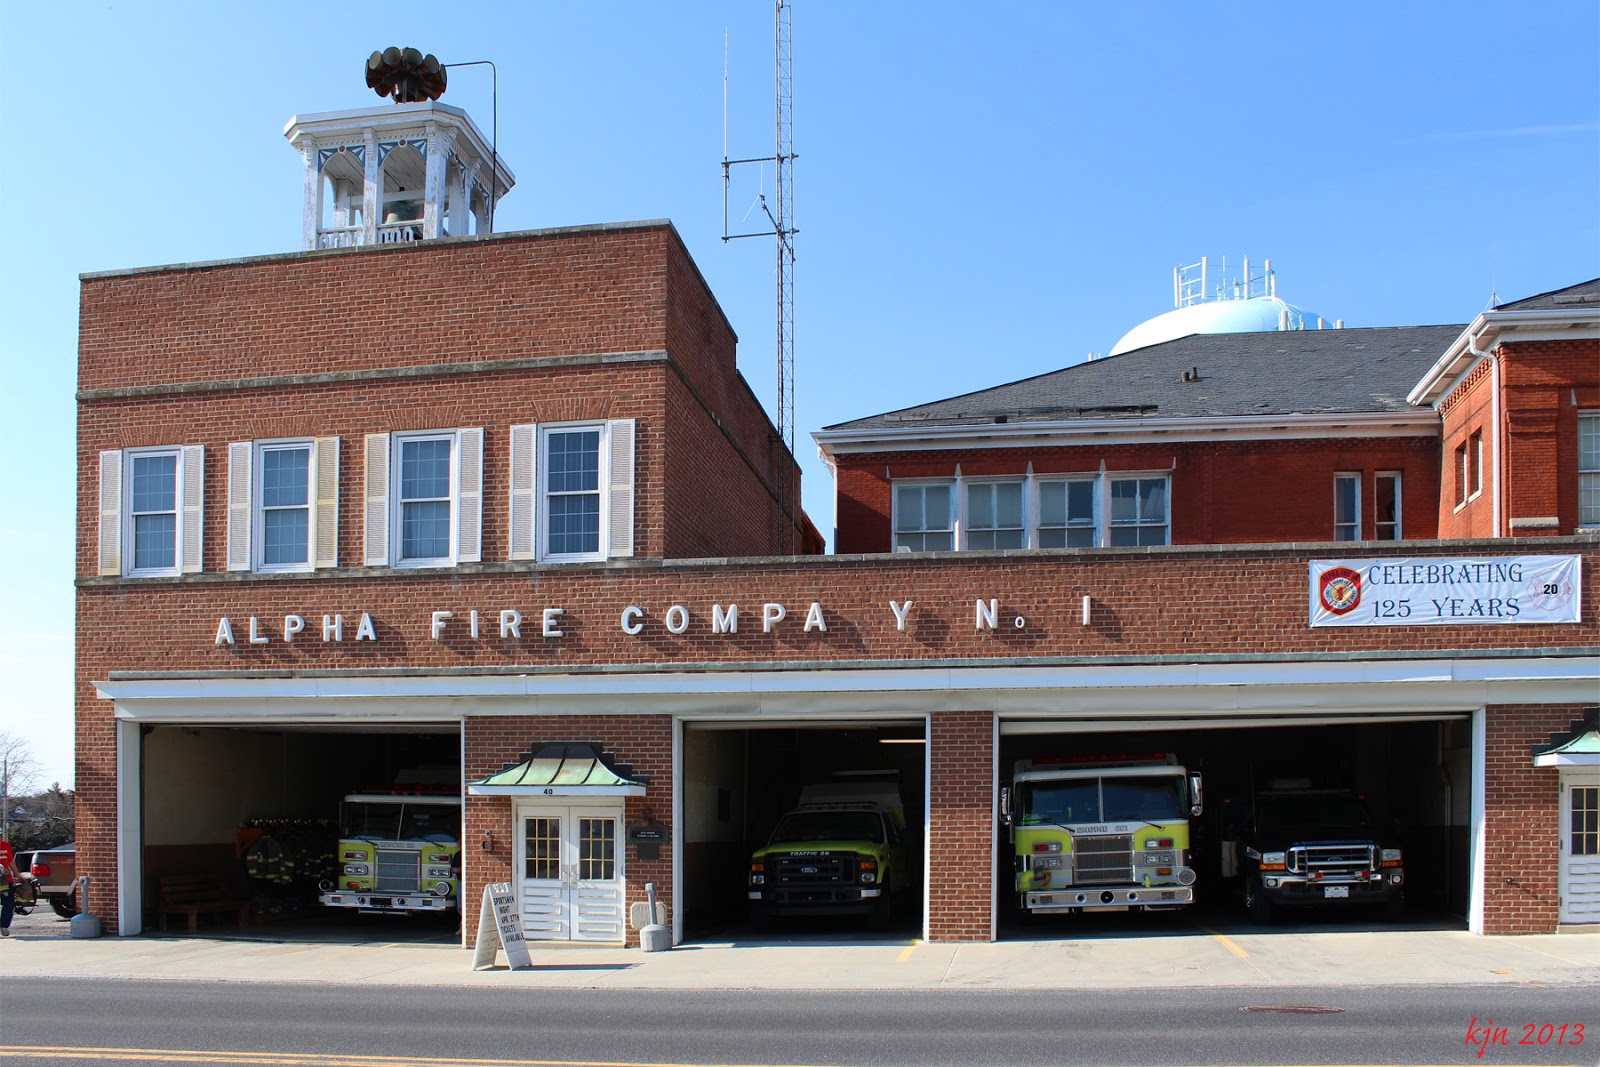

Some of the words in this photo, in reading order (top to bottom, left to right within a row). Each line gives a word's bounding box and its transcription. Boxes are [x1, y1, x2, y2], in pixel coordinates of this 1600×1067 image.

[1368, 563, 1523, 585] CELEBRATING
[1543, 584, 1558, 595] 20
[1372, 599, 1412, 618] 125
[1432, 597, 1521, 617] YEARS
[215, 612, 378, 645] ALPHA
[431, 608, 564, 639] FIRE
[493, 895, 515, 906] SPORTSMEN
[499, 905, 510, 915] NIGHT
[510, 914, 520, 922] 27TH
[501, 924, 516, 933] TICKETS
[506, 932, 525, 943] AVAILABLE
